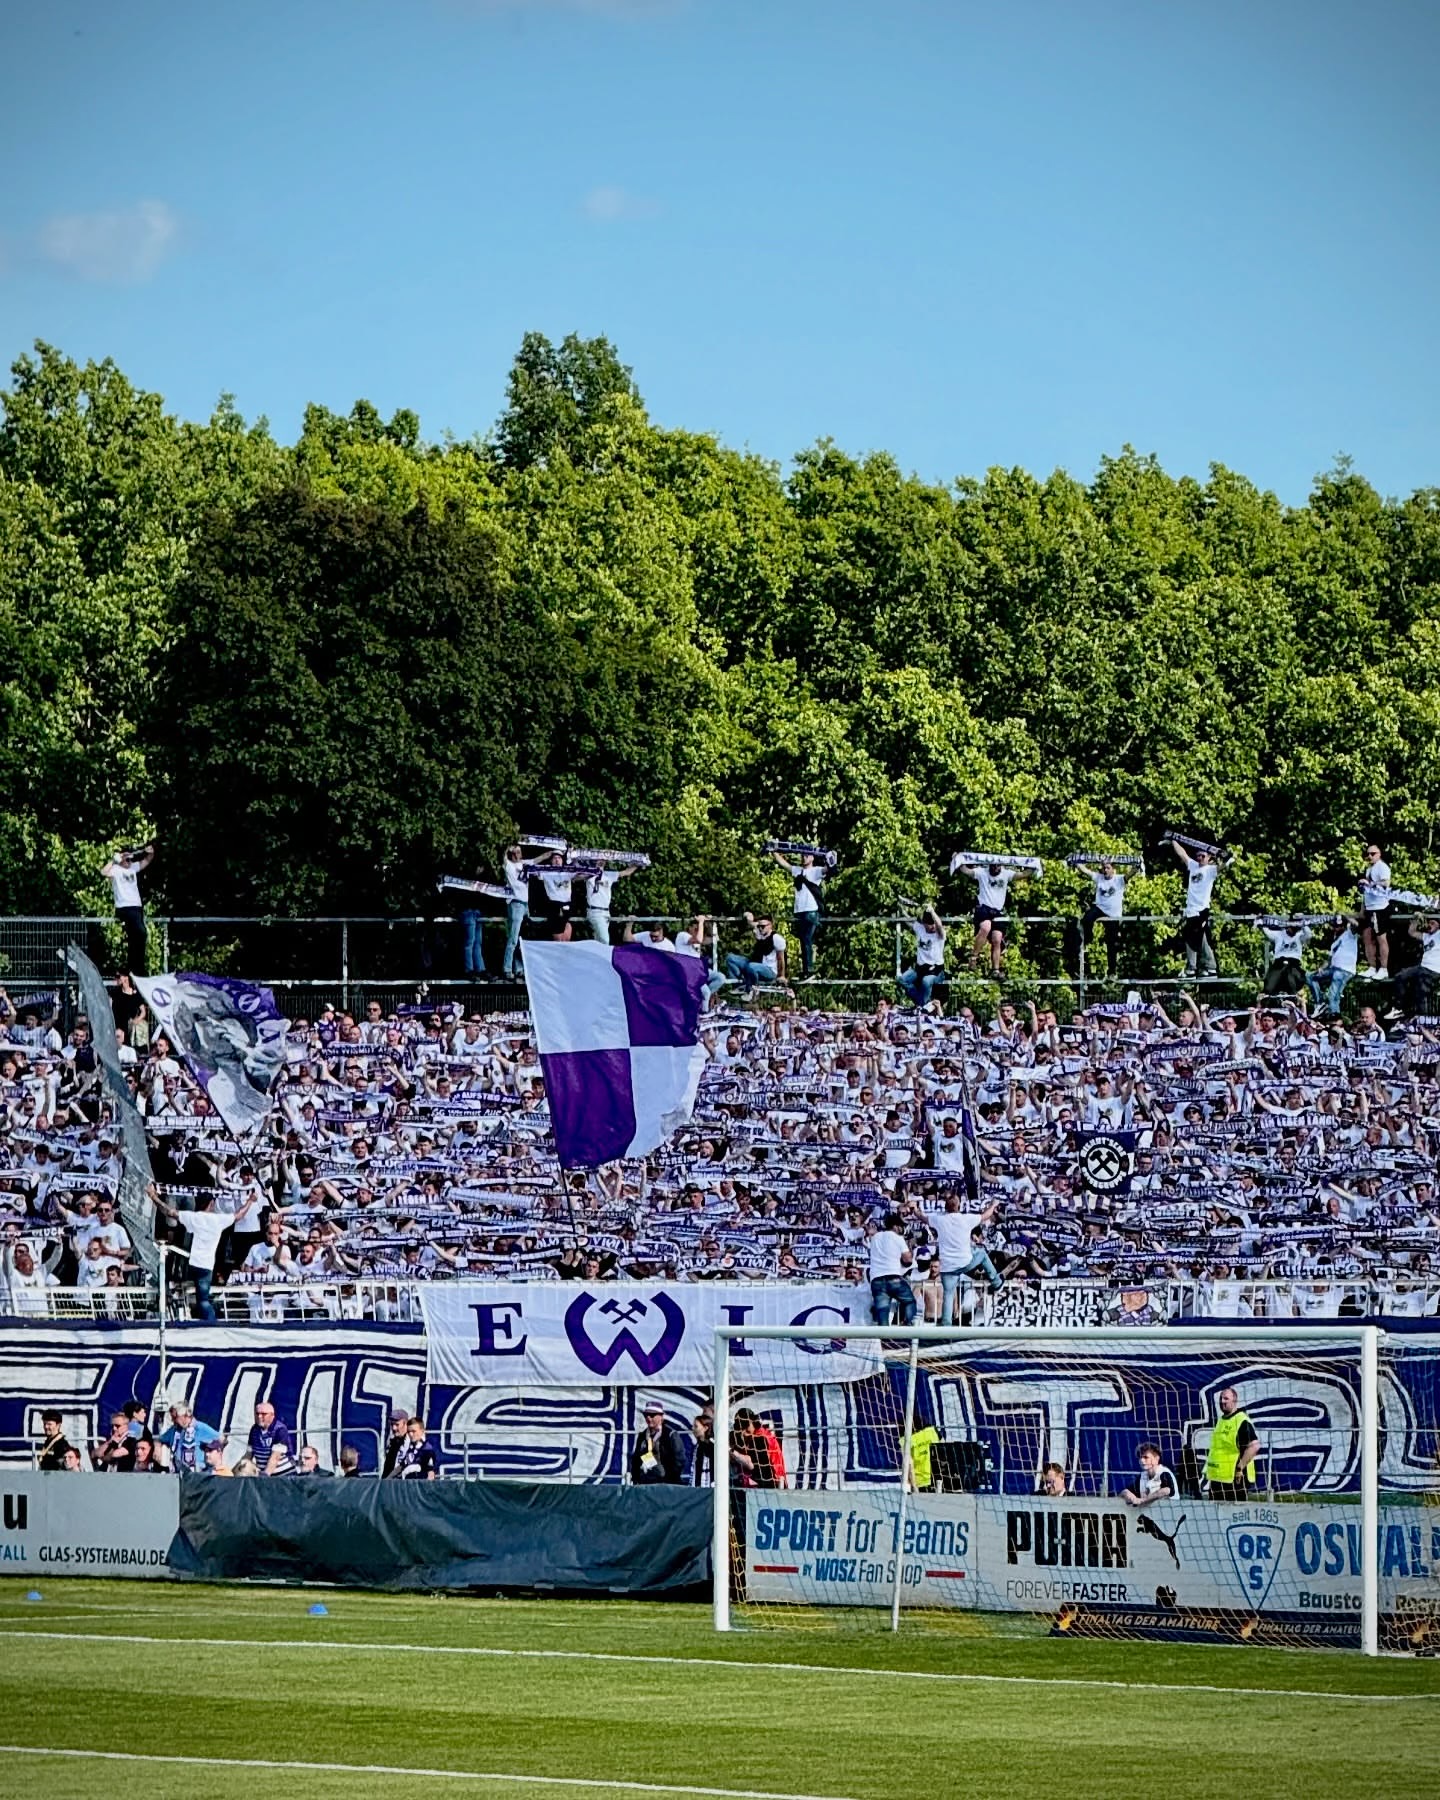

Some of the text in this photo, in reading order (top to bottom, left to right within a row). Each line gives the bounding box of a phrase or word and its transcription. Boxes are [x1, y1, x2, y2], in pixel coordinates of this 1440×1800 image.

[755, 1508, 969, 1557] SPORT for Teams
[1006, 1510, 1128, 1568] PUMA
[39, 1546, 166, 1566] GLAS-SYSTEMBAU.DE
[802, 1558, 922, 1588] BY WOSZ Fan Sop
[1079, 1612, 1133, 1627] FINALTAG
[1134, 1615, 1157, 1627] DER
[1257, 1622, 1301, 1634] FINALTAG
[1302, 1624, 1321, 1634] DER
